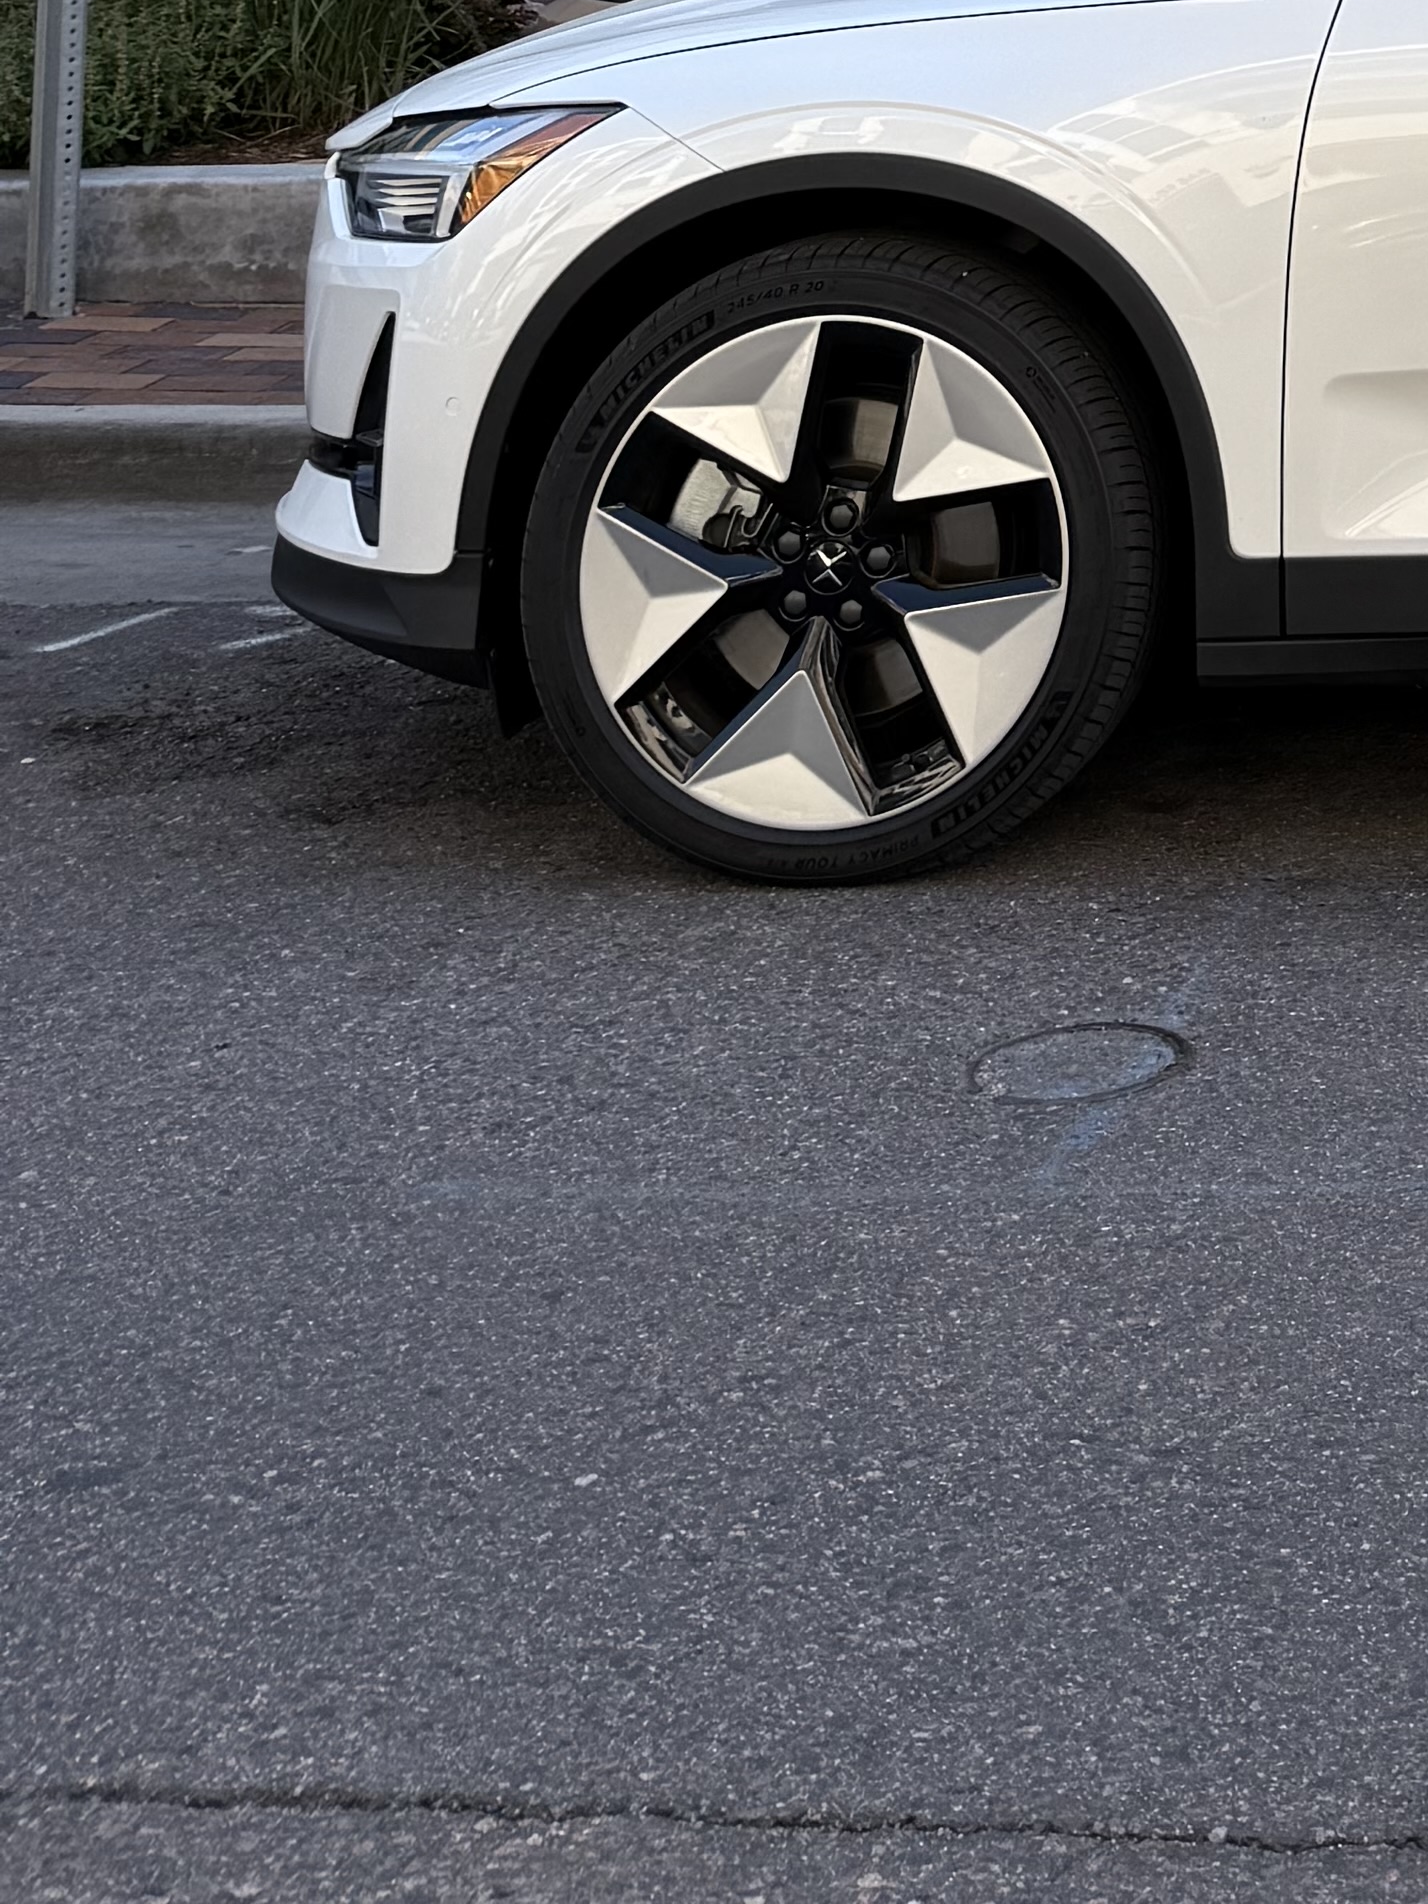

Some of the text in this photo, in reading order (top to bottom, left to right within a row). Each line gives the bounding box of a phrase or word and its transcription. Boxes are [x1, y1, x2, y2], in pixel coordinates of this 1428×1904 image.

[804, 280, 824, 294] 20
[595, 312, 712, 423] MICHELIN
[937, 725, 1057, 834] MICHELIN
